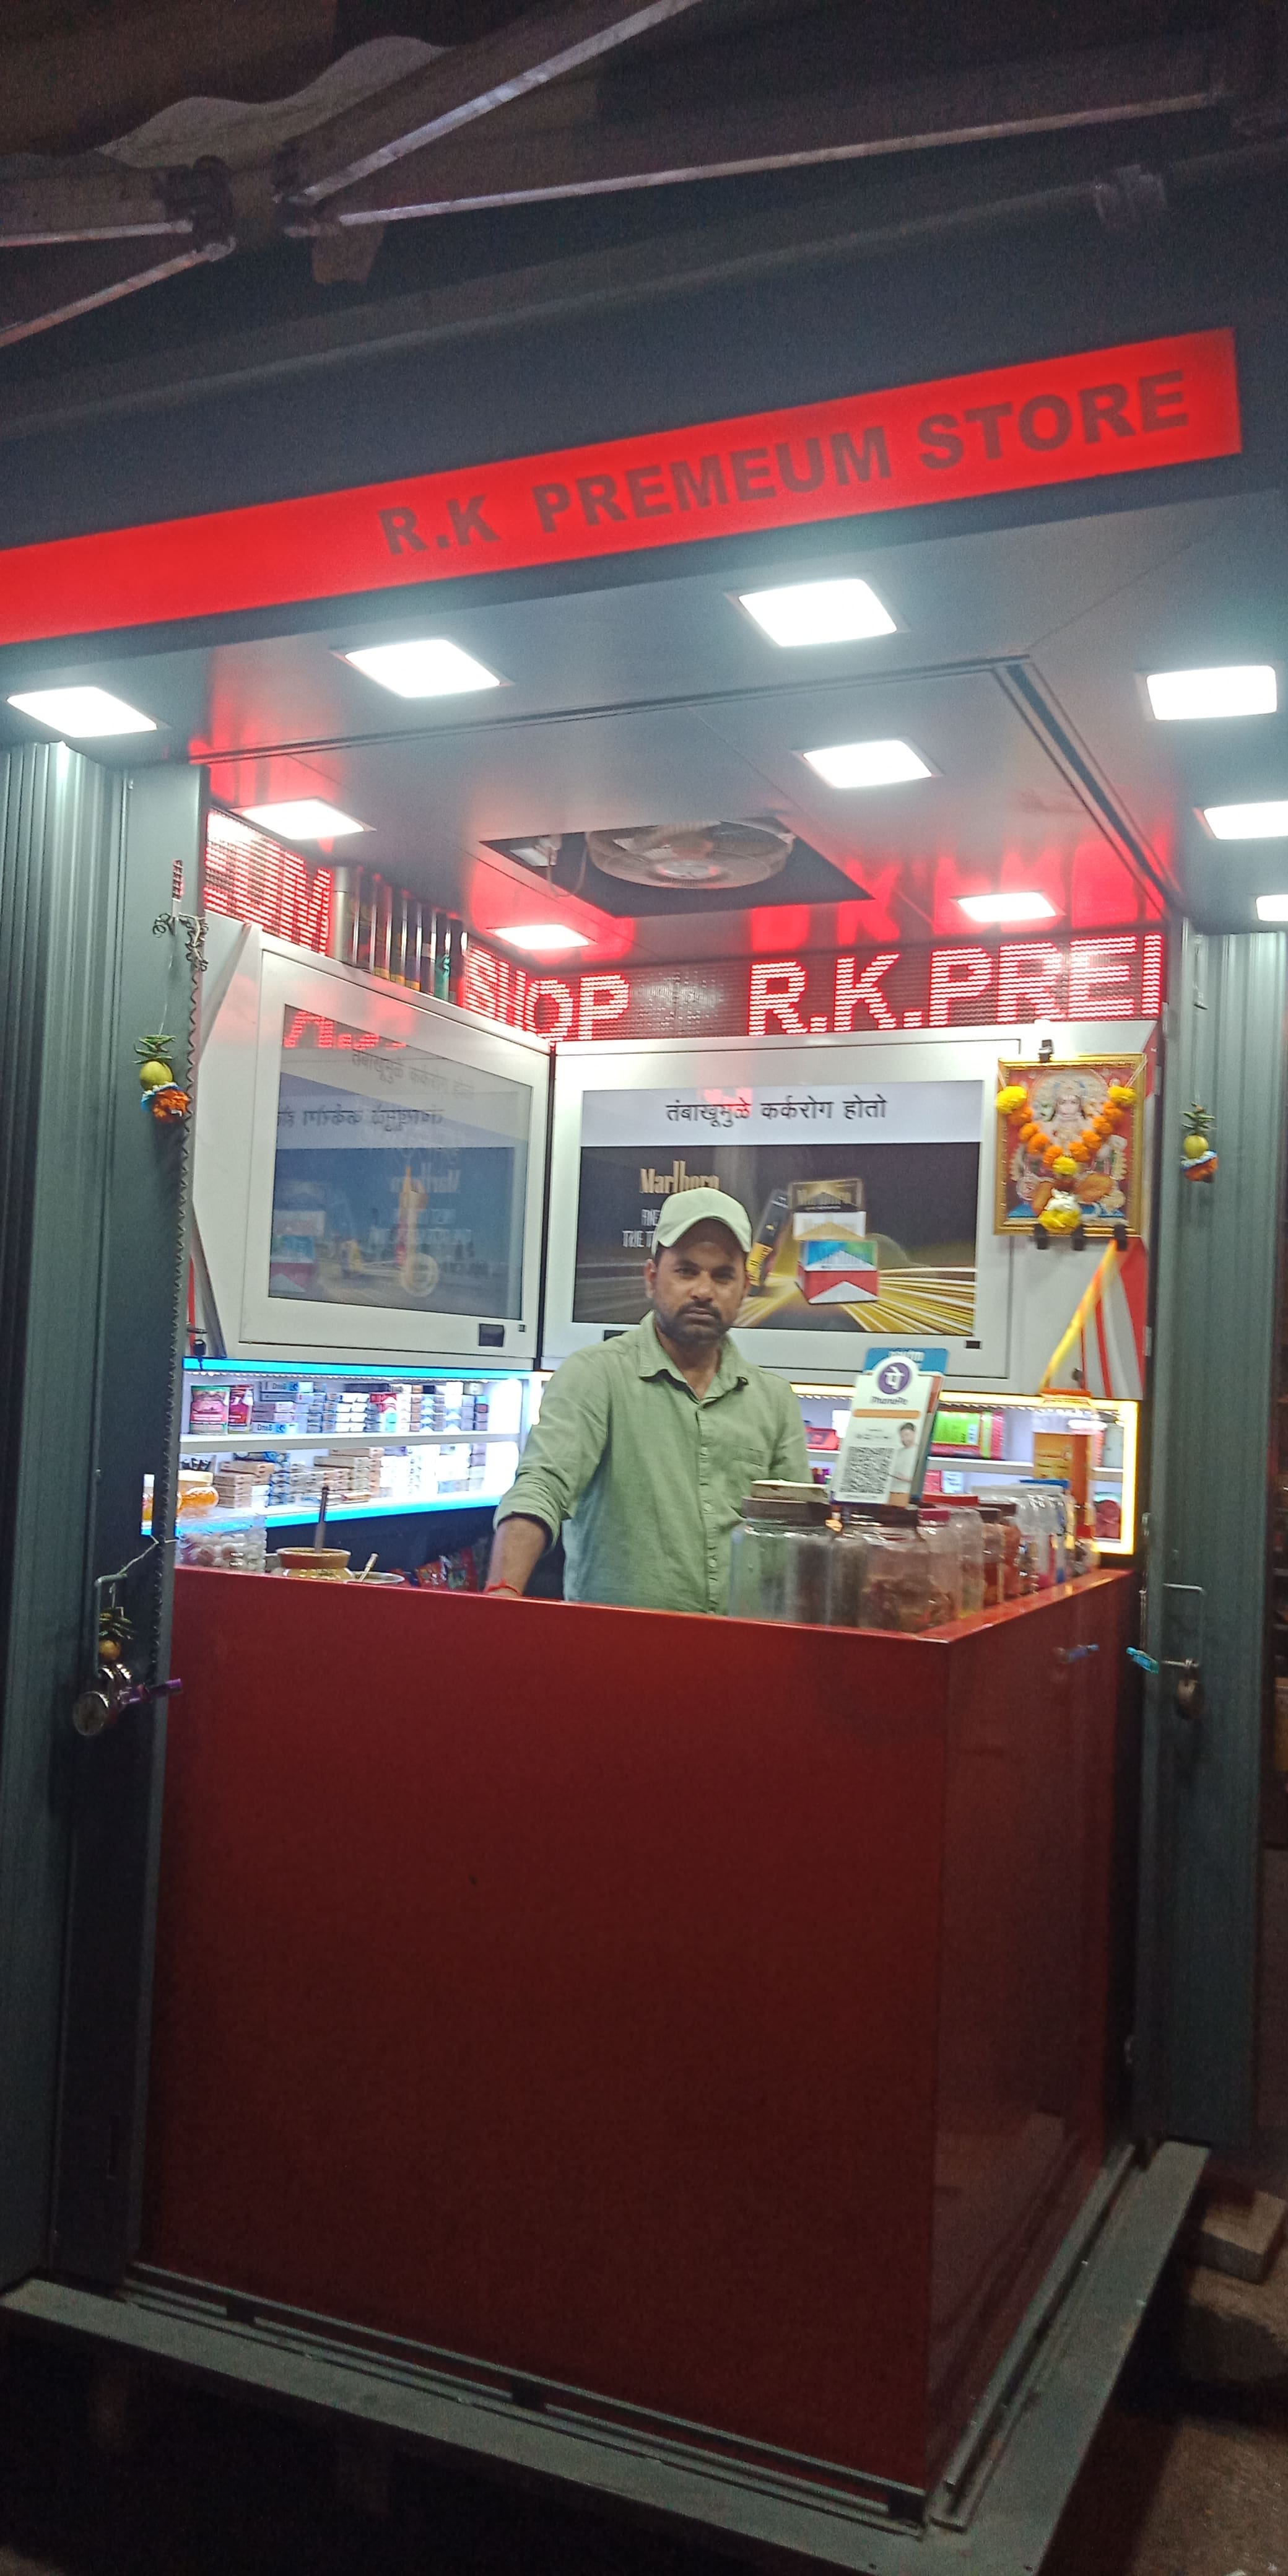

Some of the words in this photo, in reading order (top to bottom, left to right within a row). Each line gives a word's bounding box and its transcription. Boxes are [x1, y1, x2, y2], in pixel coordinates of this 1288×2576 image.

[377, 494, 500, 555] R.K
[532, 427, 892, 533] PREMEUM
[917, 371, 1189, 469] STORE
[666, 1097, 752, 1128] तंबाखूमुळे
[760, 1095, 835, 1120] कर्करोग
[842, 1094, 887, 1120] होतो
